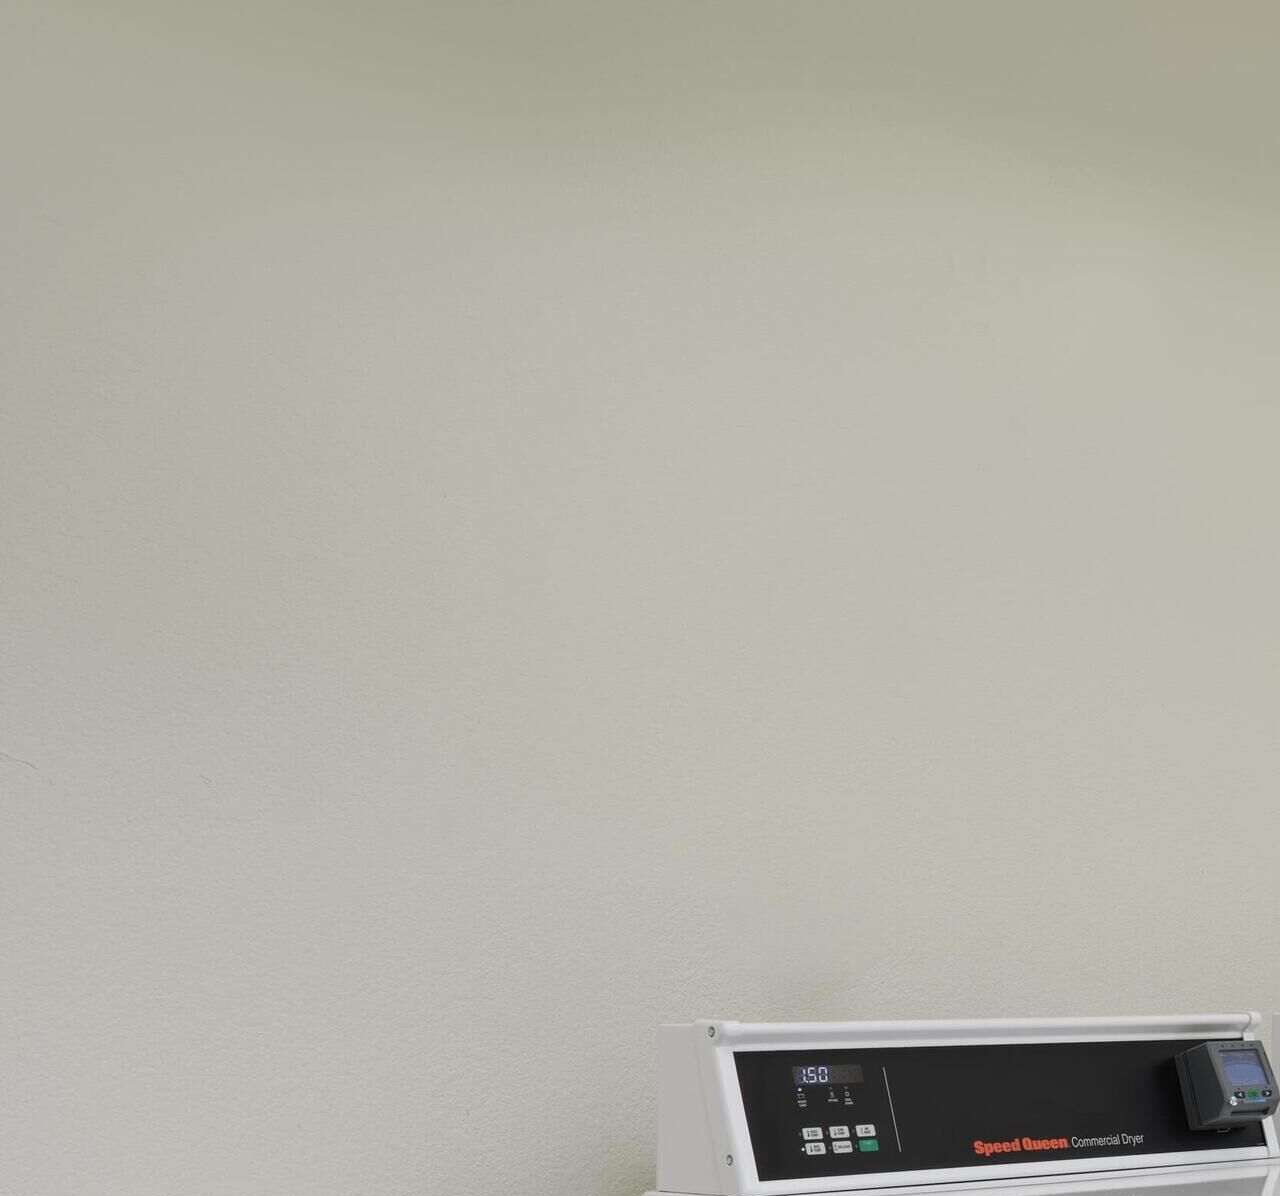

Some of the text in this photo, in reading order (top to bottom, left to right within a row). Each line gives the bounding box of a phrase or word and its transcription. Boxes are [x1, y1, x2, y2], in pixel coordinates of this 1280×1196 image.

[802, 1066, 828, 1083] 1.50
[974, 1132, 1144, 1157] Speed Queen Commercial Dryer
